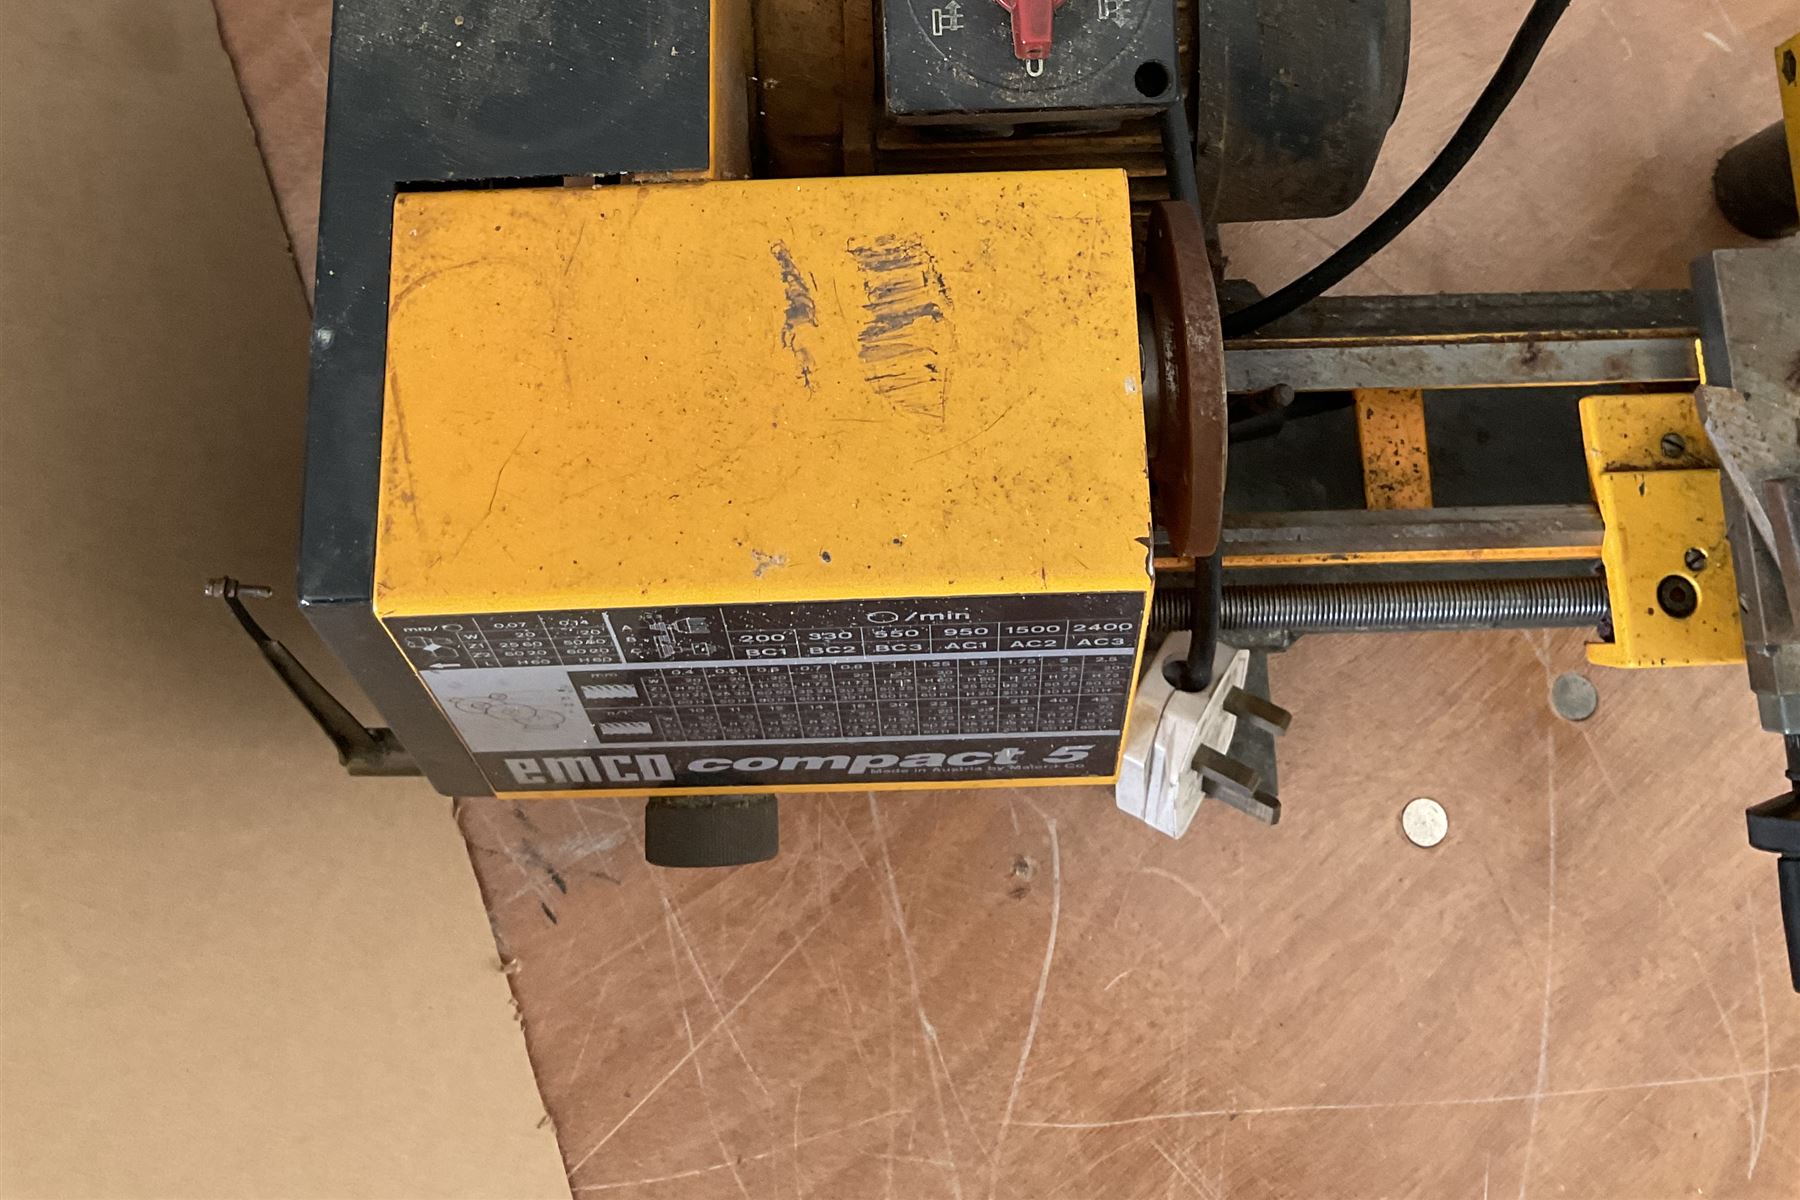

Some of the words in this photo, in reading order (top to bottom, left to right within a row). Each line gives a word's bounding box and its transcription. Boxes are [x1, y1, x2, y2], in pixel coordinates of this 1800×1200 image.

[622, 624, 633, 632] A
[944, 627, 989, 637] 950
[1005, 625, 1061, 635] 1500
[1073, 622, 1133, 632] 2400
[463, 632, 478, 640] W
[740, 633, 785, 643] 200
[808, 631, 853, 641] 330
[873, 629, 919, 639] 550
[944, 641, 987, 650] AC1
[1010, 639, 1057, 648] AC2
[1077, 637, 1125, 646] AC3
[745, 647, 787, 657] BC1
[809, 645, 856, 655] BC2
[875, 643, 922, 653] BC3
[504, 753, 675, 785] emco
[687, 747, 1026, 774] compact
[1042, 744, 1095, 763] 5
